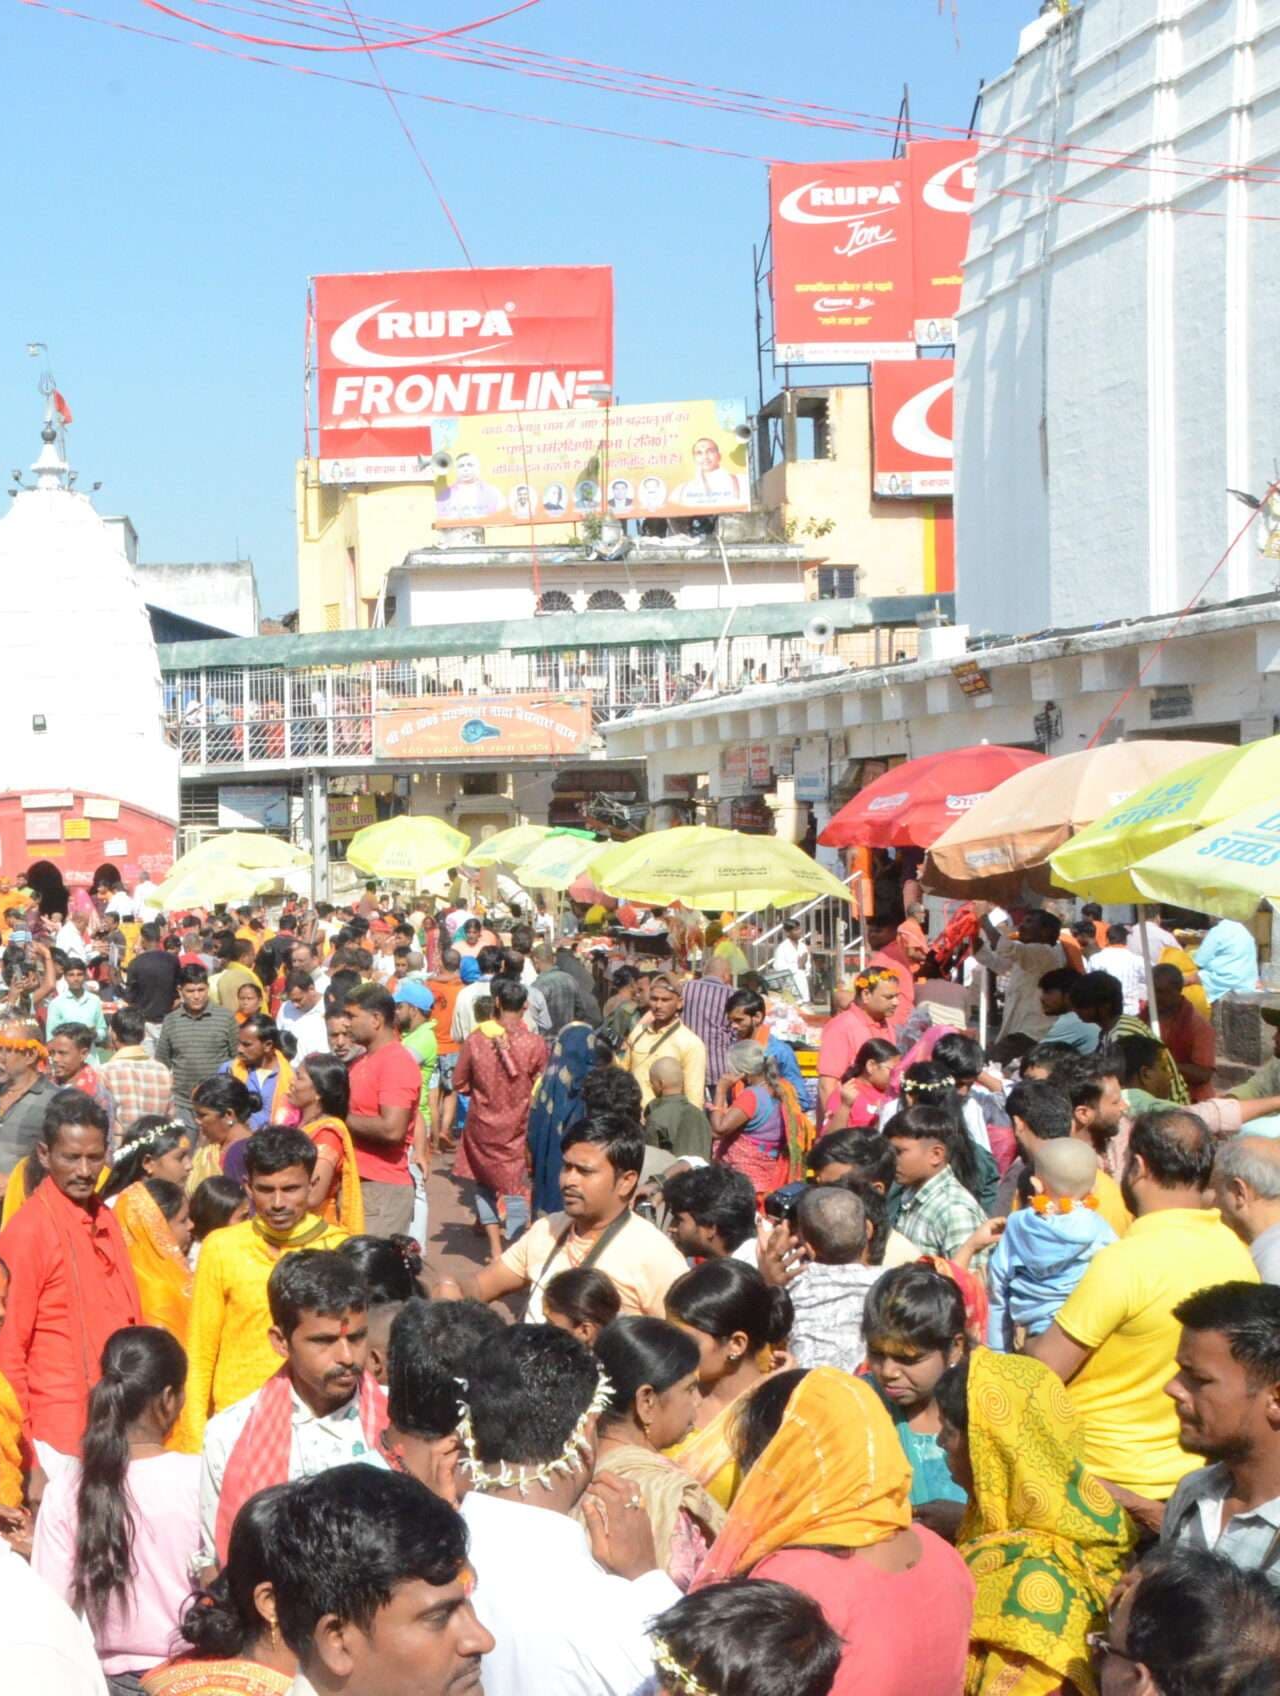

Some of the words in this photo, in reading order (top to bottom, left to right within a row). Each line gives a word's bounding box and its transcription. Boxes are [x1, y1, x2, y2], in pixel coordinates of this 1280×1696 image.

[810, 185, 901, 206] RUPA
[376, 309, 514, 340] RUPA
[331, 369, 605, 416] FRONTLINE
[1103, 796, 1193, 830] STEELS
